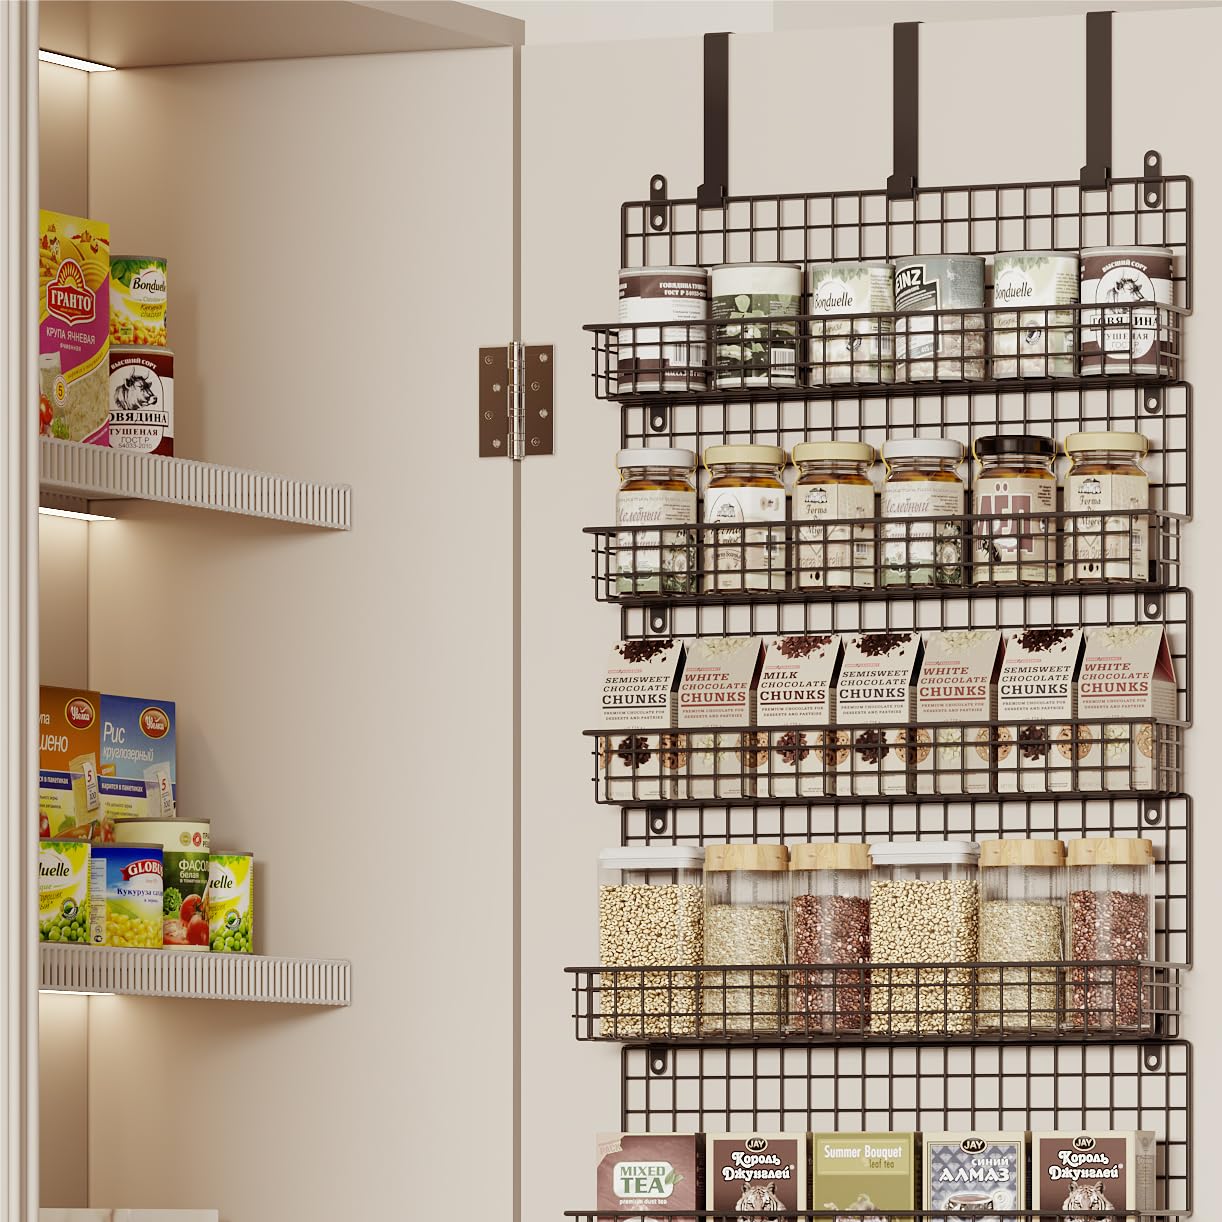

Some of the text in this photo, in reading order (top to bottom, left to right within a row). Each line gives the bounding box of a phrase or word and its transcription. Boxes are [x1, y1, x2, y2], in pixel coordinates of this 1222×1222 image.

[1131, 261, 1147, 271] СОРТ
[51, 290, 91, 311] ГРАНТО
[46, 327, 95, 345] КРУПА ЯЧНЕВАЯ
[111, 358, 157, 369] ВЫСШИЙ СОРТ
[58, 386, 63, 396] 5
[923, 667, 969, 676] WHITE
[1004, 665, 1070, 674] SEMISWEET
[1085, 663, 1131, 671] WHITE
[684, 673, 730, 682] WHITE
[763, 672, 798, 680] MILK
[842, 669, 908, 678] SEMISWEET
[1001, 674, 1069, 683] CHOCOLATE
[1082, 672, 1149, 680] CHOCOLATE
[605, 675, 671, 684] SEMISWEET
[762, 680, 827, 689] CHOCOLATE
[840, 678, 906, 686] CHOCOLATE
[920, 676, 987, 684] CHOCOLATE
[603, 684, 668, 693] CHOCOLATE
[682, 682, 747, 691] CHOCOLATE
[920, 686, 986, 697] CHUNKS
[1001, 684, 1068, 695] CHUNKS
[1081, 682, 1148, 693] CHUNKS
[681, 692, 746, 703] CHUNKS
[760, 690, 825, 700] CHUNKS
[839, 687, 905, 699] CHUNKS
[602, 694, 667, 705] CHUNKS
[104, 722, 125, 743] Рис
[104, 746, 154, 762] круглозерный
[88, 771, 92, 782] 5
[162, 779, 166, 791] 5
[749, 1140, 765, 1149] JAY
[964, 1140, 983, 1150] JAY
[1076, 1138, 1092, 1147] JAY
[824, 1145, 902, 1160] Summer Bouquet
[731, 1151, 781, 1167] Король
[869, 1159, 894, 1168] leaf tea
[1058, 1150, 1109, 1167] Король
[620, 1166, 666, 1176] MIXED
[722, 1166, 790, 1181] Джунглей
[939, 1168, 1010, 1182] АЛМАЗ
[1048, 1165, 1119, 1181] Джунглей
[621, 1178, 664, 1194] TEA
